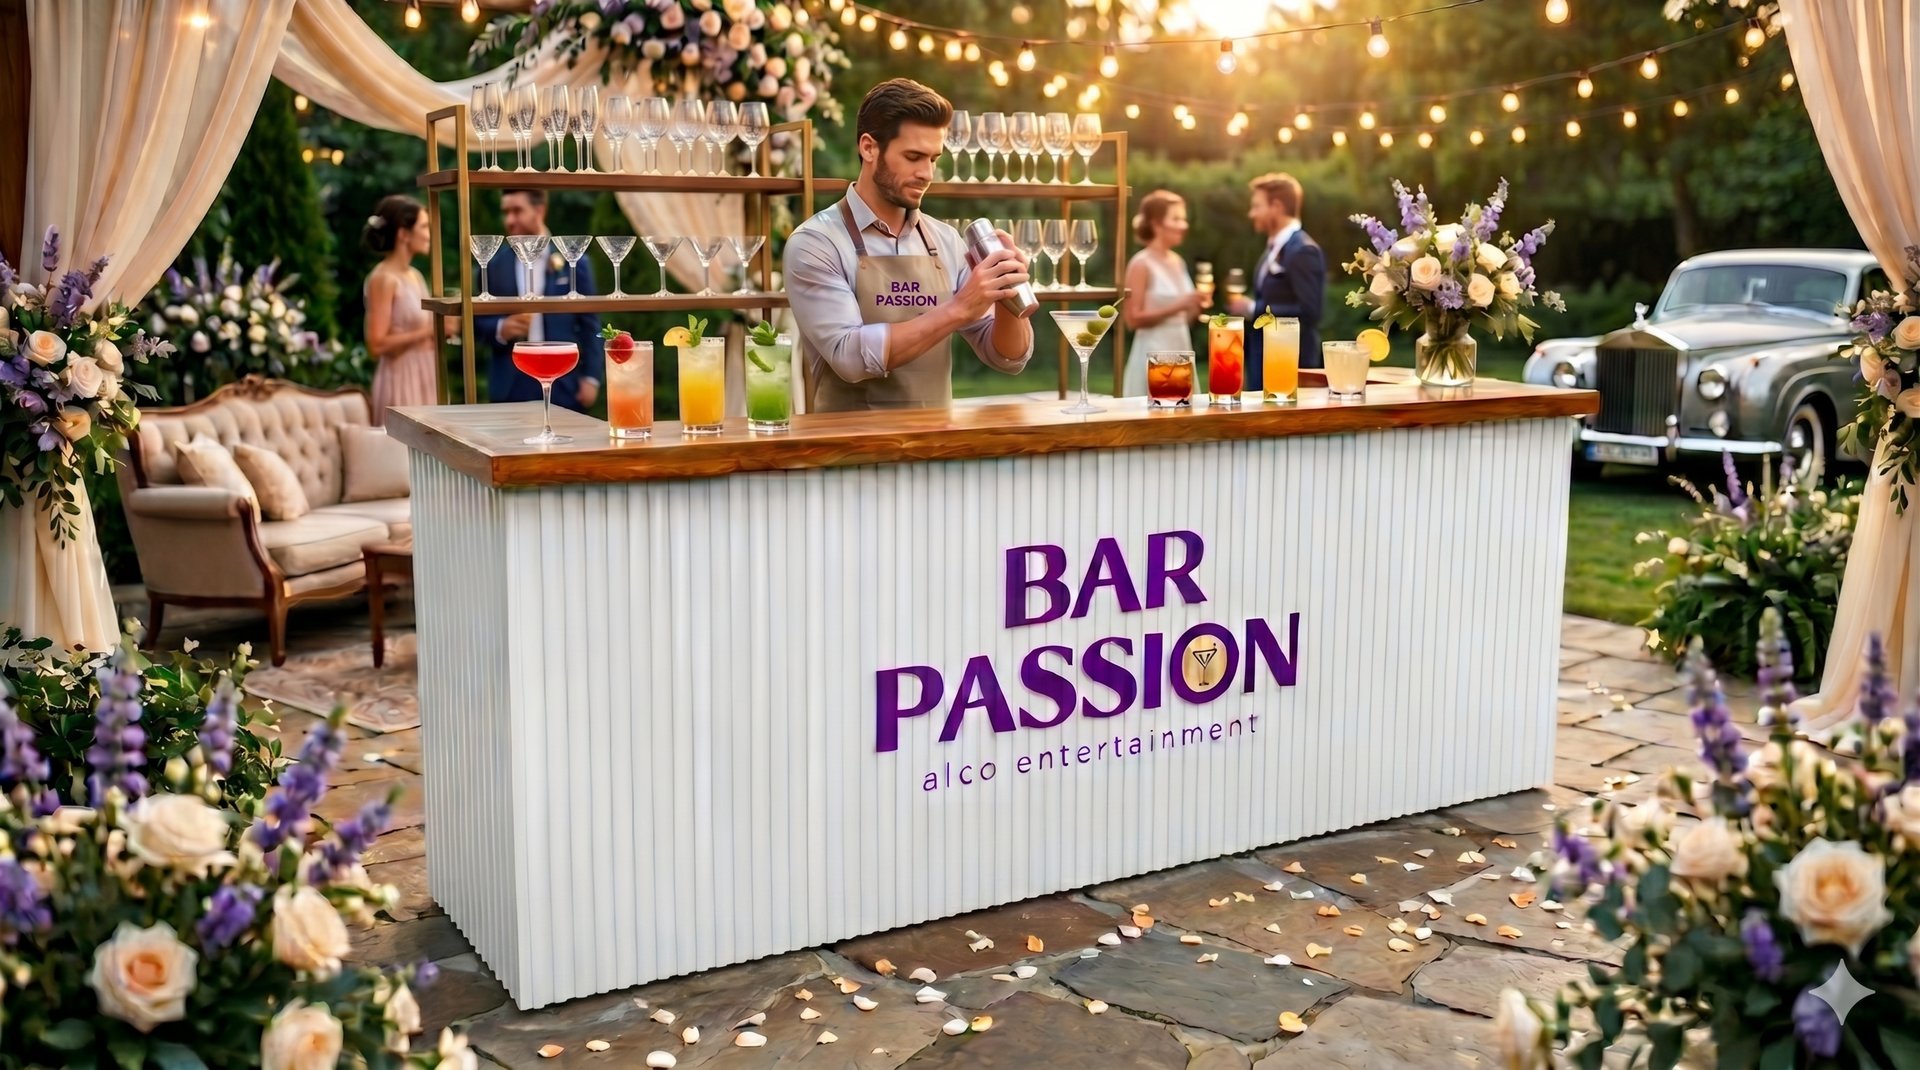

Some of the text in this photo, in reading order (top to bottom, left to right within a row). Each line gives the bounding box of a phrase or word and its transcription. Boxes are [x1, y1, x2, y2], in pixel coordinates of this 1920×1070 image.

[876, 295, 937, 306] PASSION
[891, 282, 920, 293] BAR
[1005, 530, 1207, 628] BAR
[876, 612, 1300, 752] PASSION
[923, 713, 1259, 791] alco entertainment
